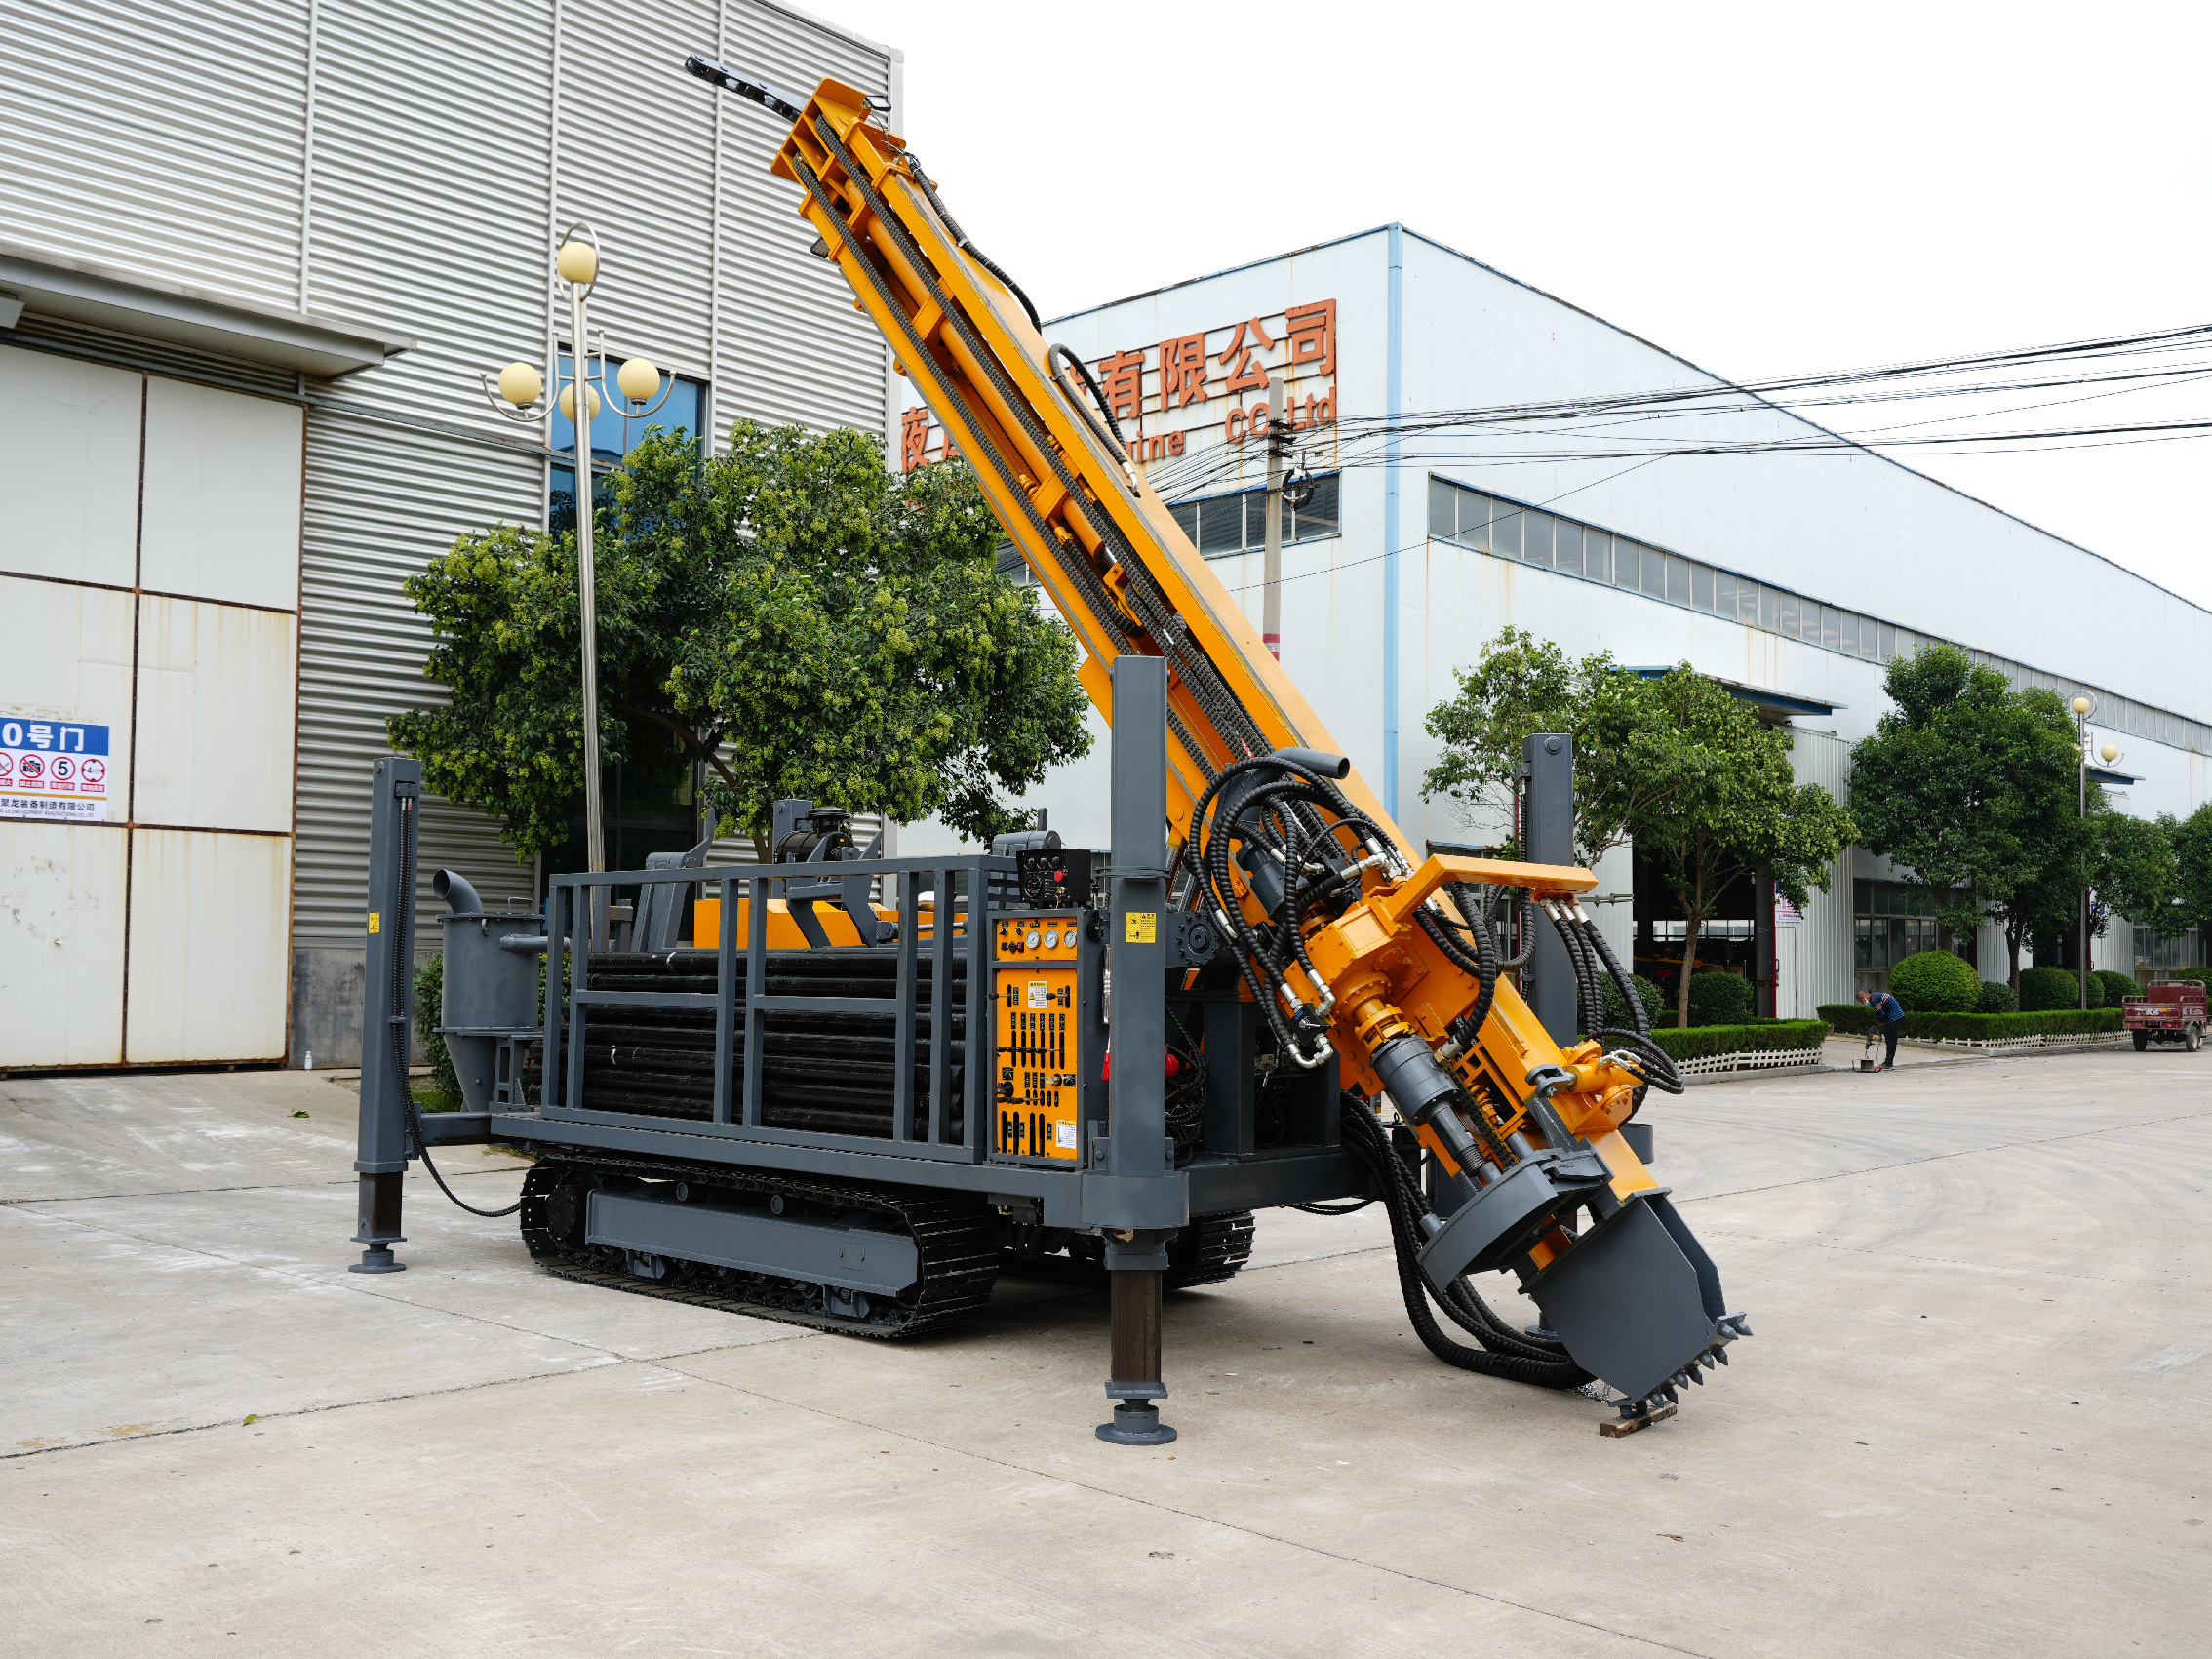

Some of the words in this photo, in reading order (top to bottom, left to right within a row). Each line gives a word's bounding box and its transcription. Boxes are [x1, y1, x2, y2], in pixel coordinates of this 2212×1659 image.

[1070, 298, 1336, 419] 有限公司
[2, 722, 84, 751] 0号门
[59, 761, 68, 776] 5
